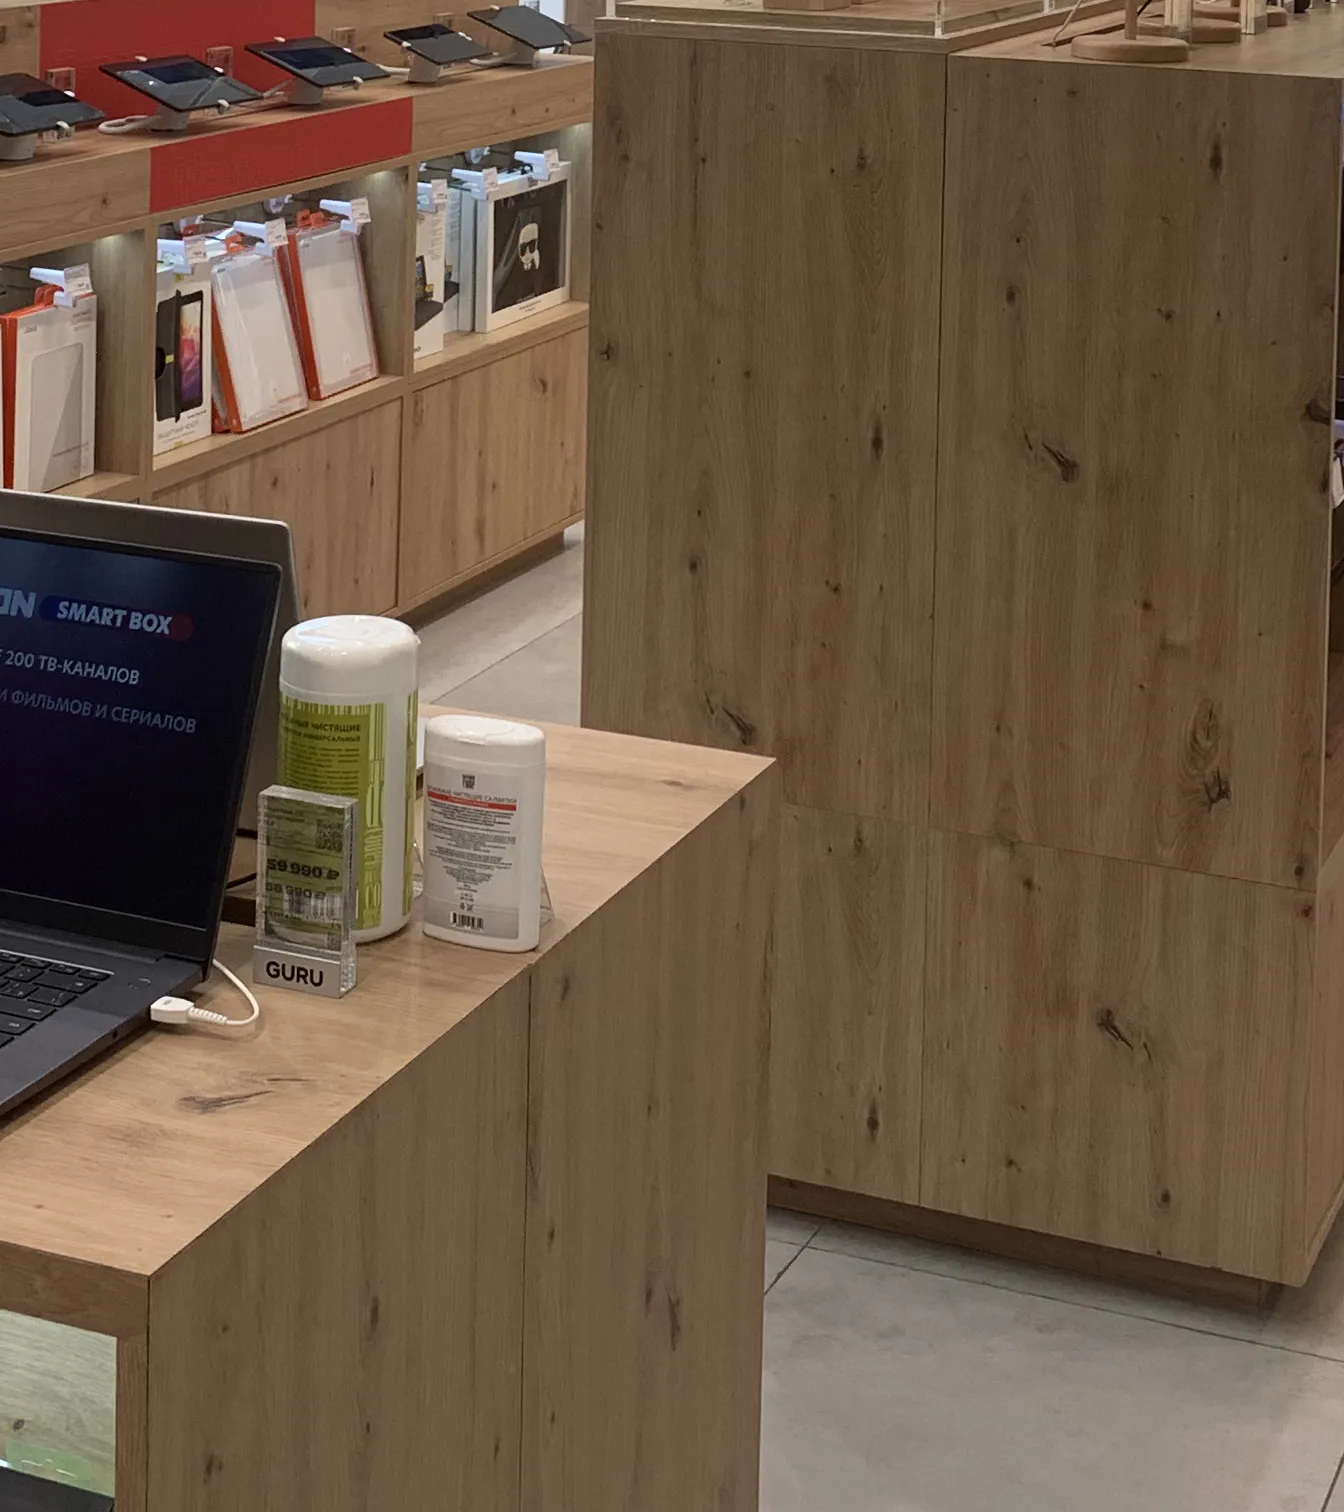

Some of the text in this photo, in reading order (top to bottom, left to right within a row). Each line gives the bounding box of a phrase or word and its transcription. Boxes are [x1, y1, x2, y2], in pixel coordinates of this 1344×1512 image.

[56, 600, 127, 628] SMART
[128, 611, 173, 635] BOX
[5, 650, 35, 669] 200
[38, 654, 140, 685] ТВ-КАНАЛОВ
[11, 689, 93, 717] ФИЛЬМОВ
[95, 704, 108, 719] И
[110, 705, 197, 734] СЕРИАЛОВ
[265, 960, 324, 987] GURU
